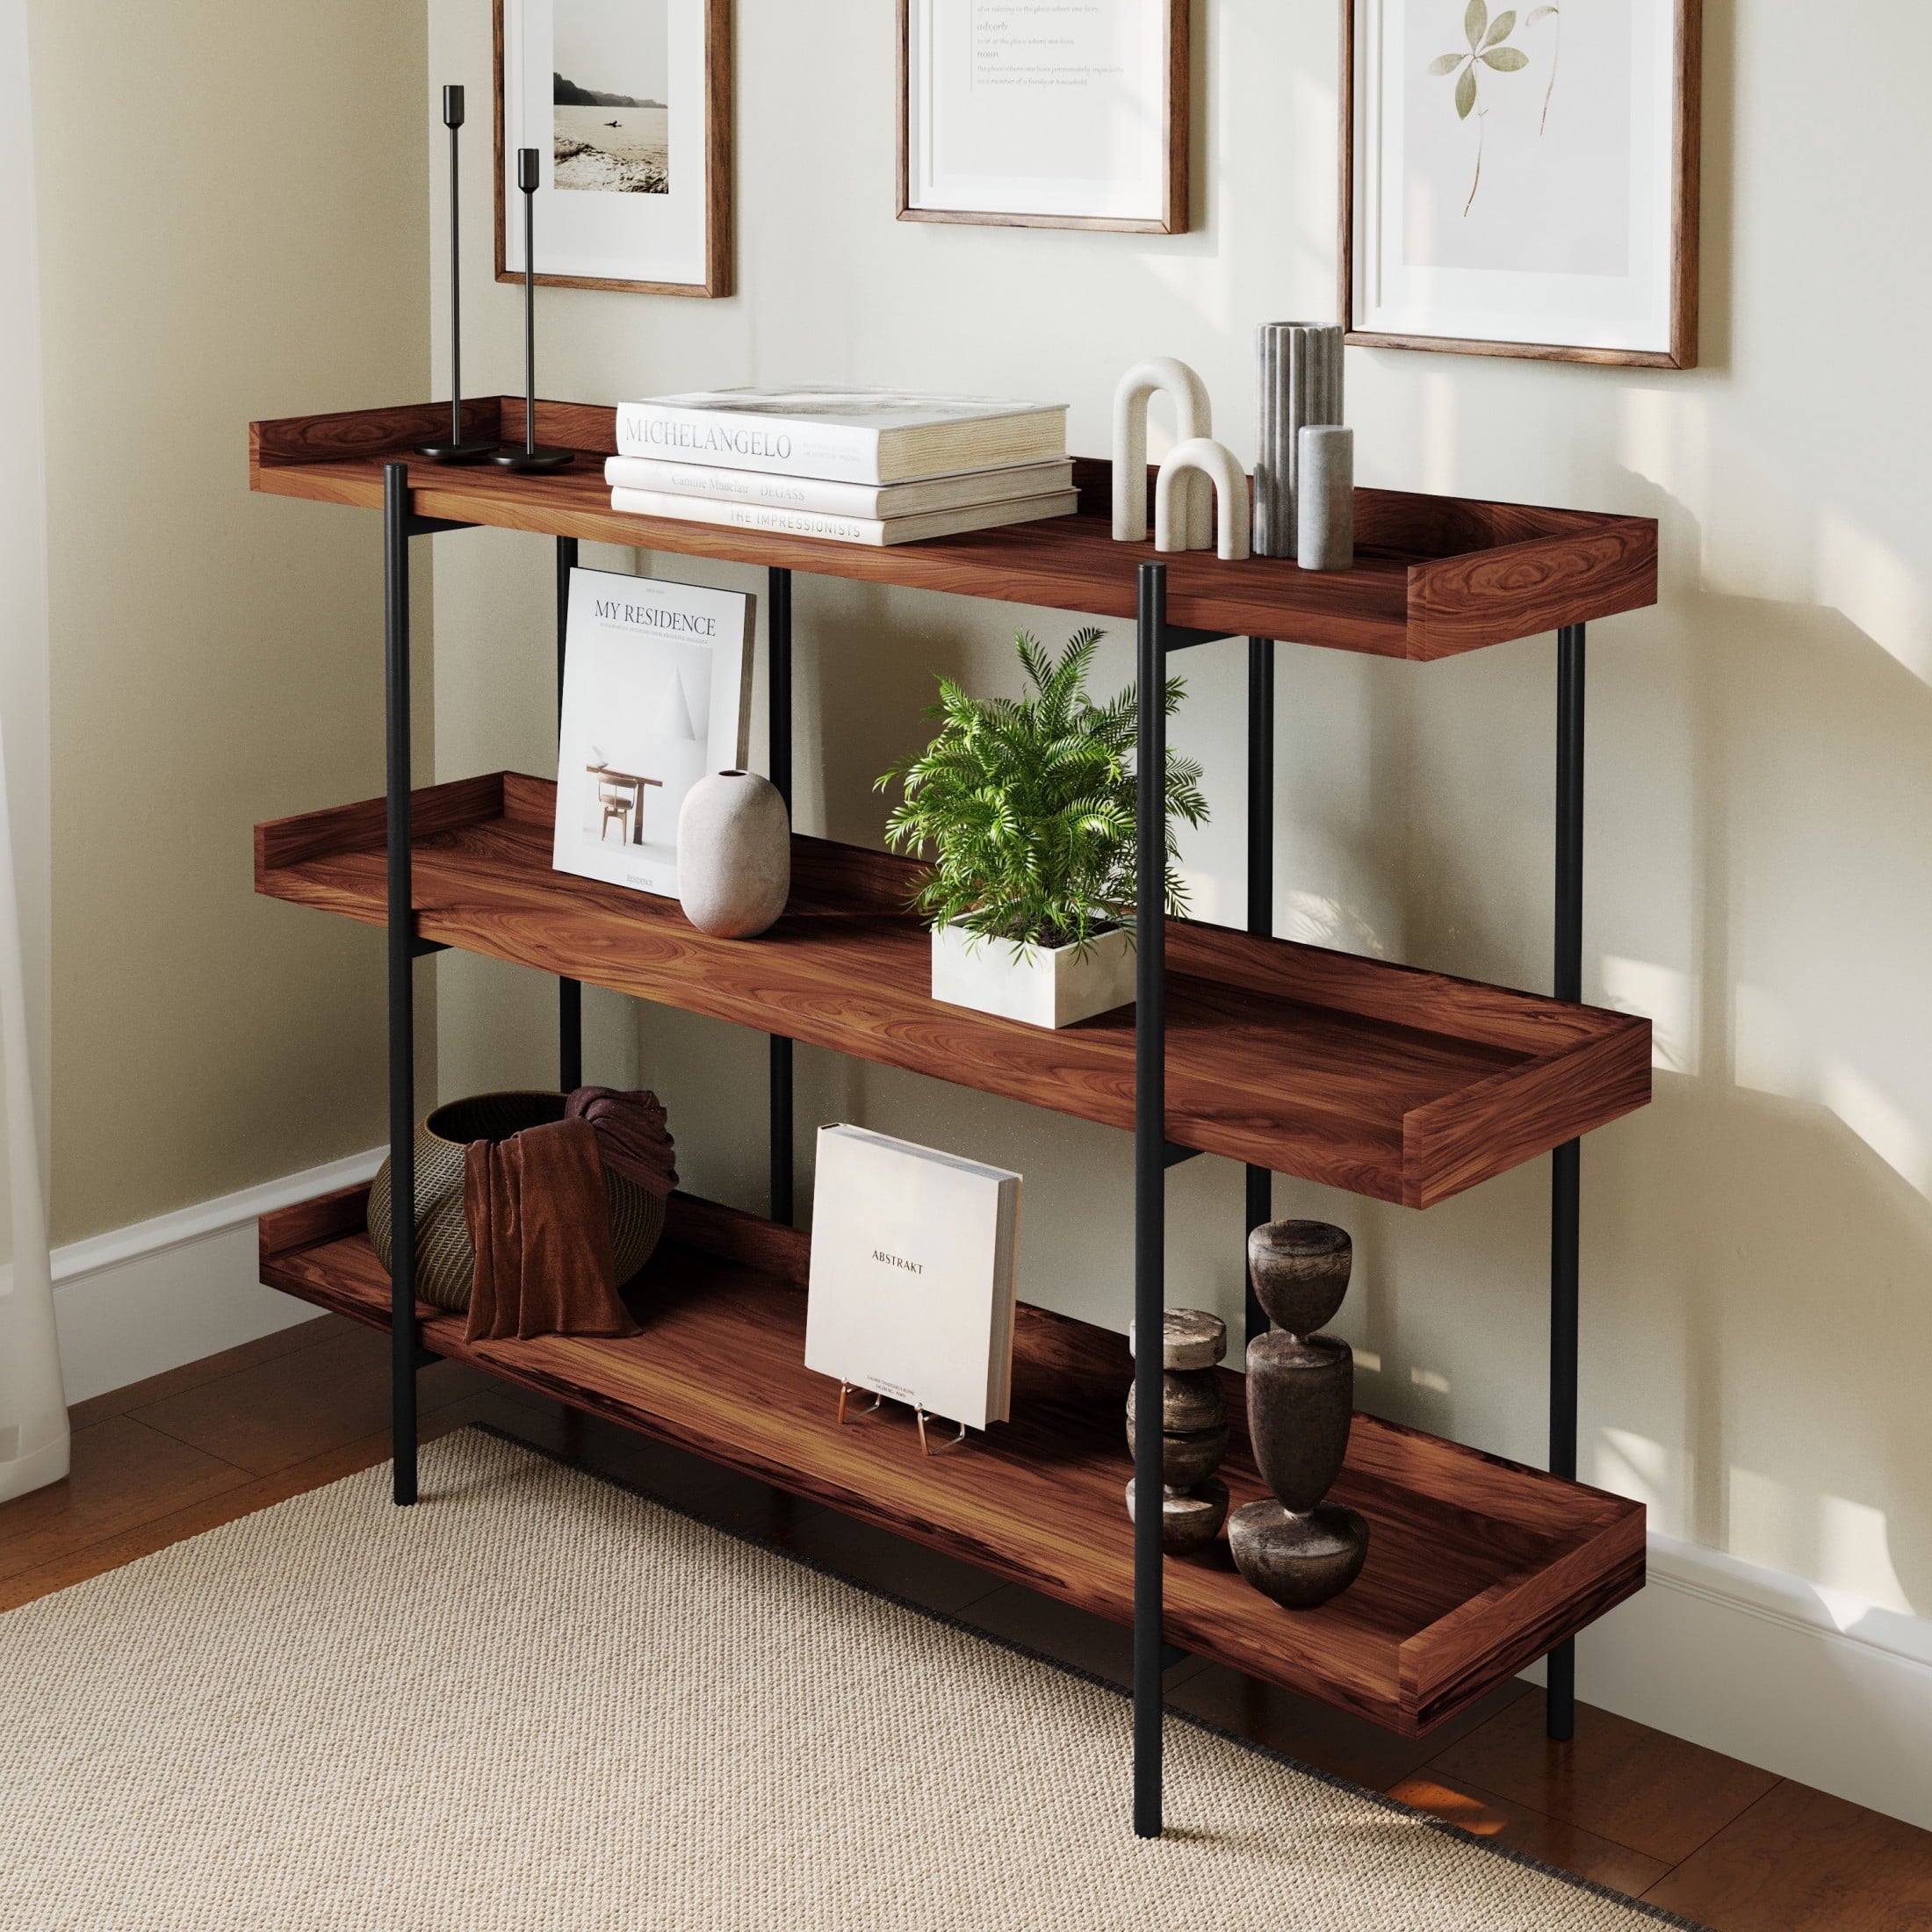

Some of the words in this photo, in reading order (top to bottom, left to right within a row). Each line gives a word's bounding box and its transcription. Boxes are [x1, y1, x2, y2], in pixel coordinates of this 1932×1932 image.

[977, 21, 1007, 32] adverb
[625, 417, 792, 459] MICHELANGELO
[672, 474, 707, 489] Camille
[709, 478, 750, 494] Mauclair
[761, 484, 805, 501] DEGASS
[731, 508, 752, 523] THE
[757, 513, 861, 537] IMPRESSIONISTS
[594, 599, 621, 620] MY
[624, 604, 717, 637] RESIDENCE
[872, 1250, 924, 1275] ABSTRAKT
